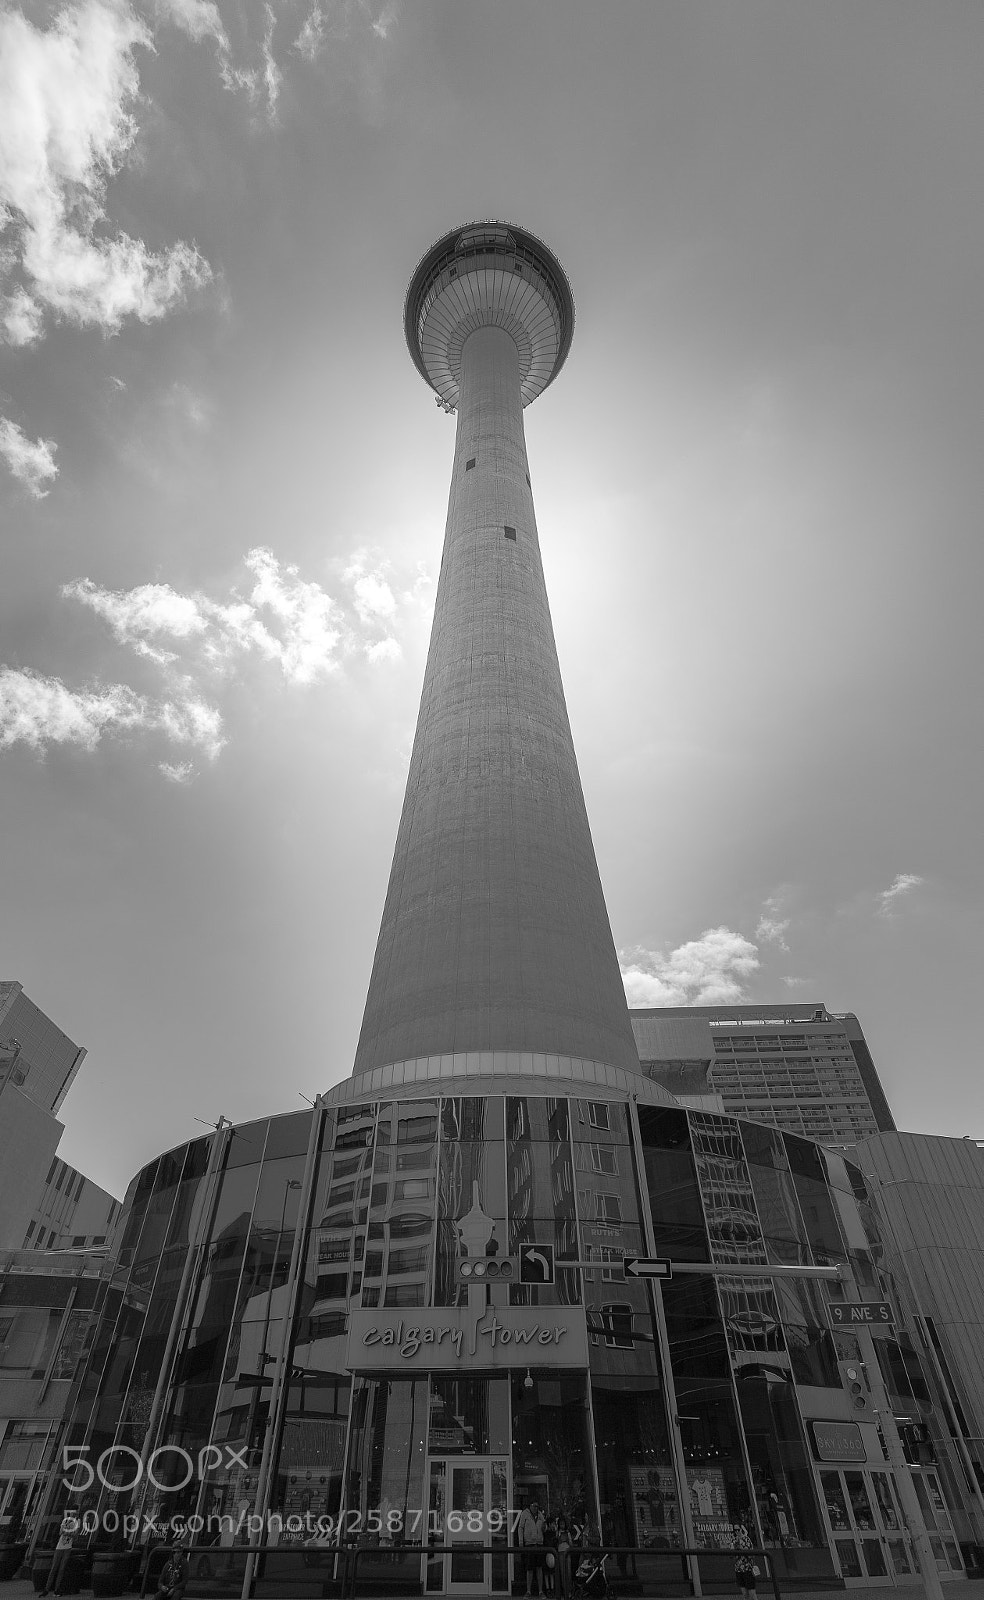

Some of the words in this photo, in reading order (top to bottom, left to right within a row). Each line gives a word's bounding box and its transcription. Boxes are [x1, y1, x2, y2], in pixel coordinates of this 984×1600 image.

[834, 1308, 843, 1320] 9
[851, 1307, 873, 1320] AVE
[879, 1306, 889, 1320] S
[362, 1320, 464, 1358] calgary
[480, 1317, 568, 1348] tower
